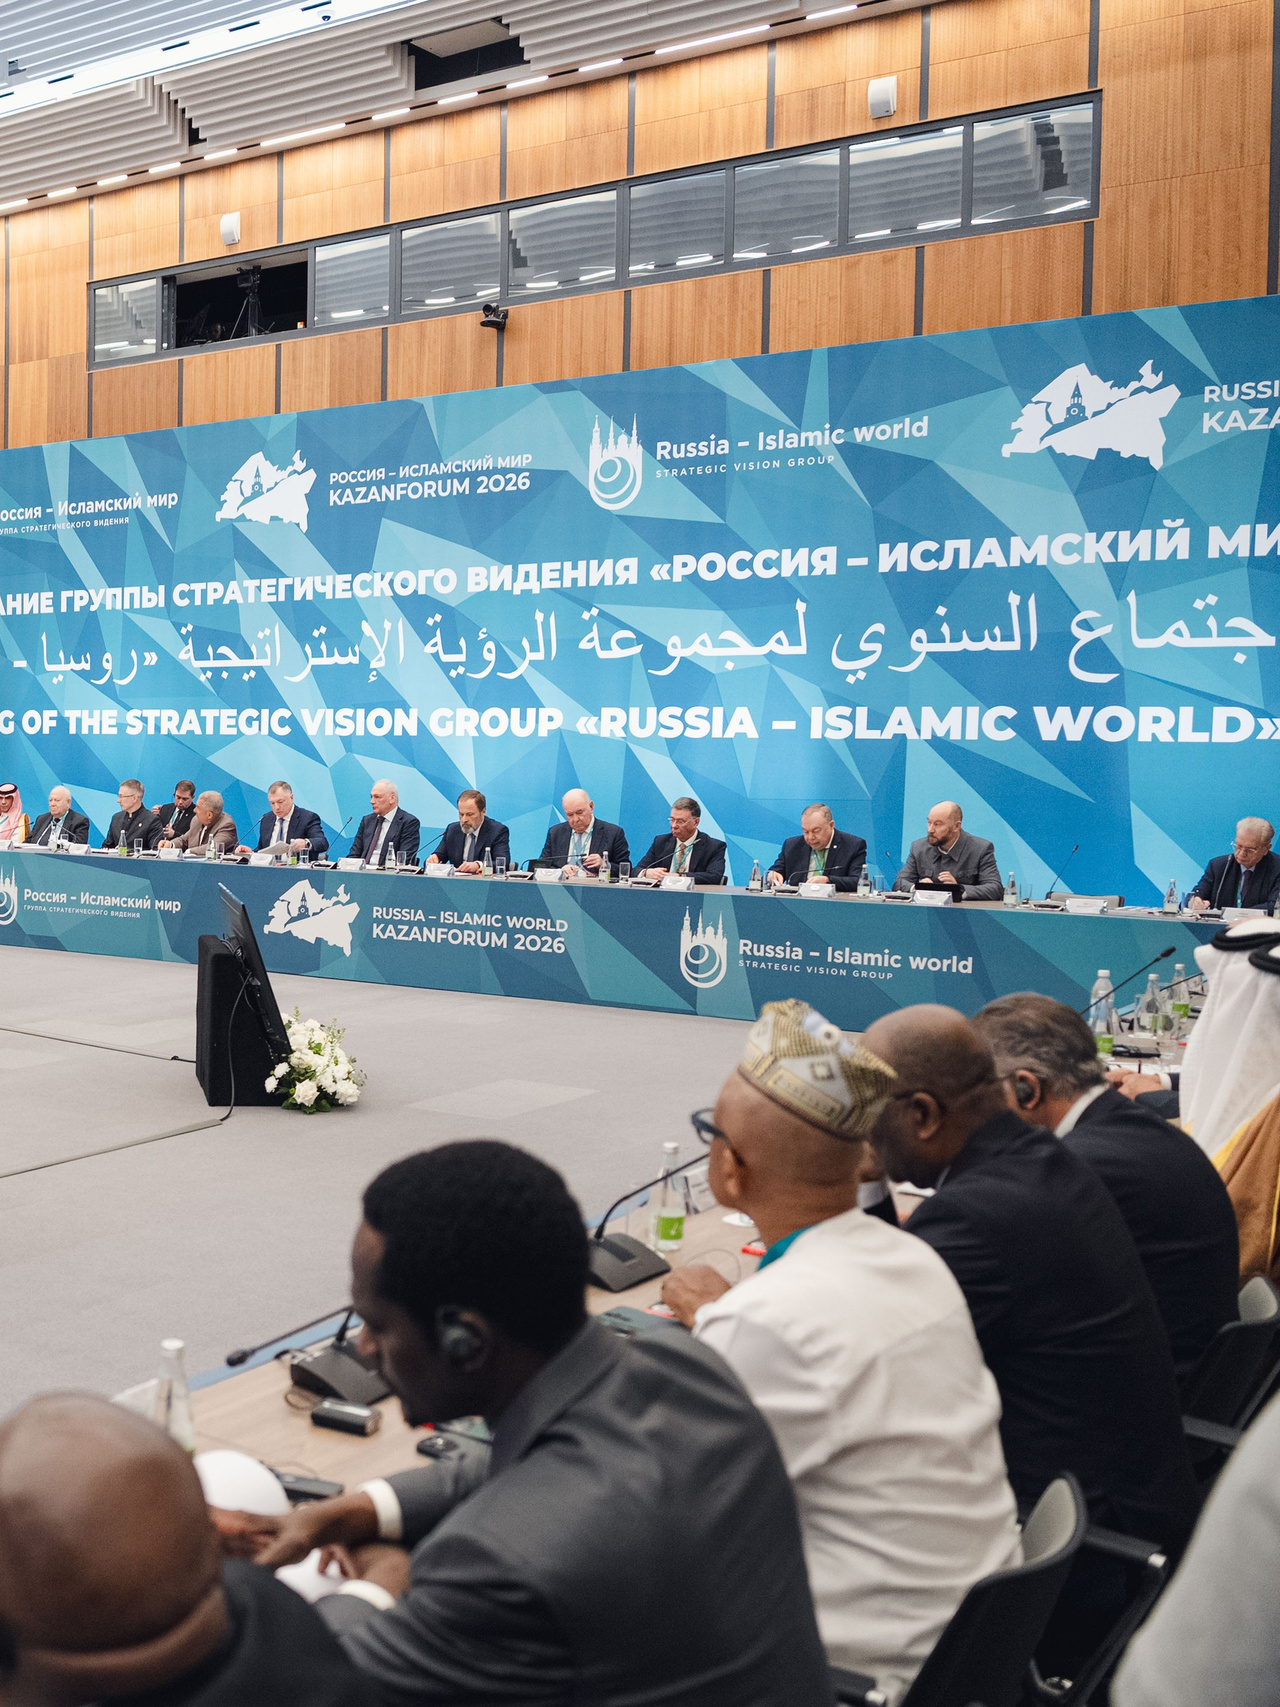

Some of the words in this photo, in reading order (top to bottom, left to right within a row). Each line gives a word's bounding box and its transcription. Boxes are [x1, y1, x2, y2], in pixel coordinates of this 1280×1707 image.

[656, 434, 730, 460] Russia
[758, 422, 845, 452] Islamic
[853, 415, 929, 443] world
[329, 469, 386, 486] РОССИЯ
[399, 454, 493, 478] ИСЛАМСКИЙ
[497, 453, 533, 470] МИР
[656, 463, 727, 479] STRATEGIC
[734, 459, 781, 472] VISION
[788, 454, 836, 468] GROUP
[58, 492, 142, 516] Исламский
[147, 492, 179, 510] мир
[328, 477, 471, 507] KAZANFORUM
[476, 471, 531, 495] 2026
[20, 520, 91, 534] СТРАТЕГИЧЕСКОГО
[93, 516, 130, 528] ВИДЕНИЯ
[59, 584, 166, 613] ГРУППЫ
[172, 567, 457, 607] СТРАТЕГИЧЕСКОГО
[467, 557, 639, 595] ВИДЕНИЯ
[649, 546, 838, 583] «РОССИЯ
[878, 518, 1191, 573] ИСЛАМСКИЙ
[177, 612, 405, 684] الإستراتيجية
[423, 608, 558, 680] الرؤية
[578, 597, 808, 676] لمجموعة
[831, 590, 1038, 684] السنوي
[21, 709, 59, 735] OF
[63, 709, 119, 735] THE
[125, 707, 293, 736] STRATEGIC
[301, 707, 419, 736] VISION
[428, 707, 564, 738] GROUP
[575, 706, 759, 739] «RUSSIA
[810, 705, 1018, 741] ISLAMIC
[1033, 705, 1280, 743] WORLD»
[23, 904, 47, 912] ГРУППА
[49, 906, 108, 916] СТРАТЕГИЧЕСКОГО
[111, 910, 141, 919] ВИДЕНИЯ
[24, 888, 67, 903] Россия
[80, 892, 151, 909] Исламский
[154, 900, 182, 913] мир
[372, 906, 425, 923] RUSSIA
[439, 910, 502, 928] ISLAMIC
[506, 914, 568, 933] WORLD
[372, 922, 508, 949] KAZANFORUM
[513, 934, 566, 954] 2026
[738, 938, 803, 961] Russia
[827, 946, 902, 969] Islamic
[909, 955, 974, 975] world
[738, 959, 801, 973] STRATEGIC
[806, 965, 847, 977] VISION
[852, 969, 894, 980] GROUP
